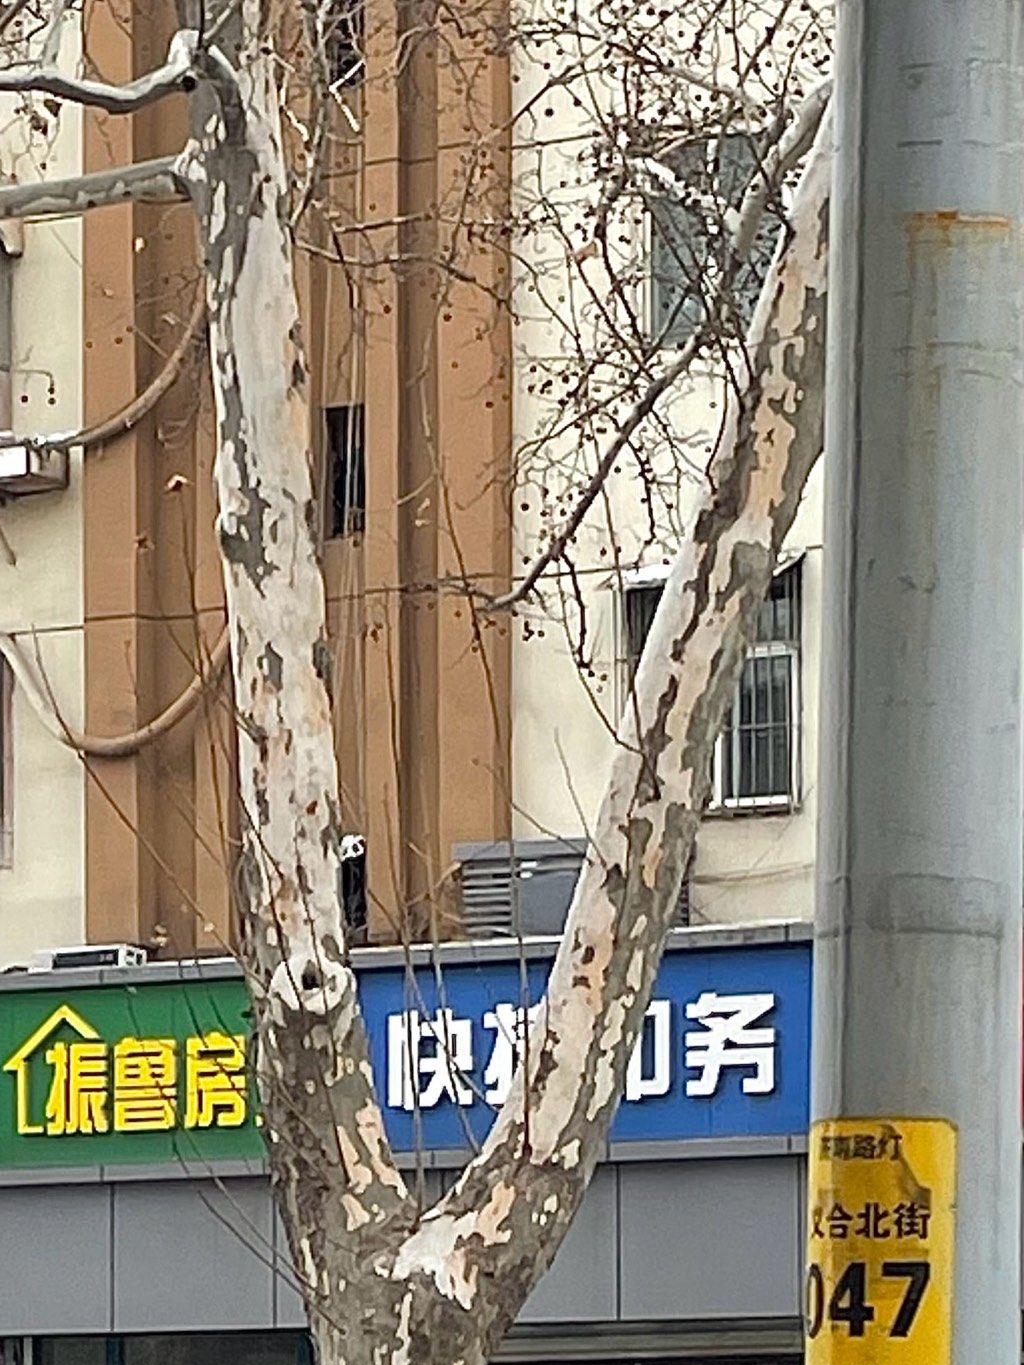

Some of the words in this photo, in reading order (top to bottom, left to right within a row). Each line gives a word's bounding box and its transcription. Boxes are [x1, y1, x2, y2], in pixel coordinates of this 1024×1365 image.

[45, 1031, 264, 1135] 振鲁房
[807, 1261, 932, 1339] 047
